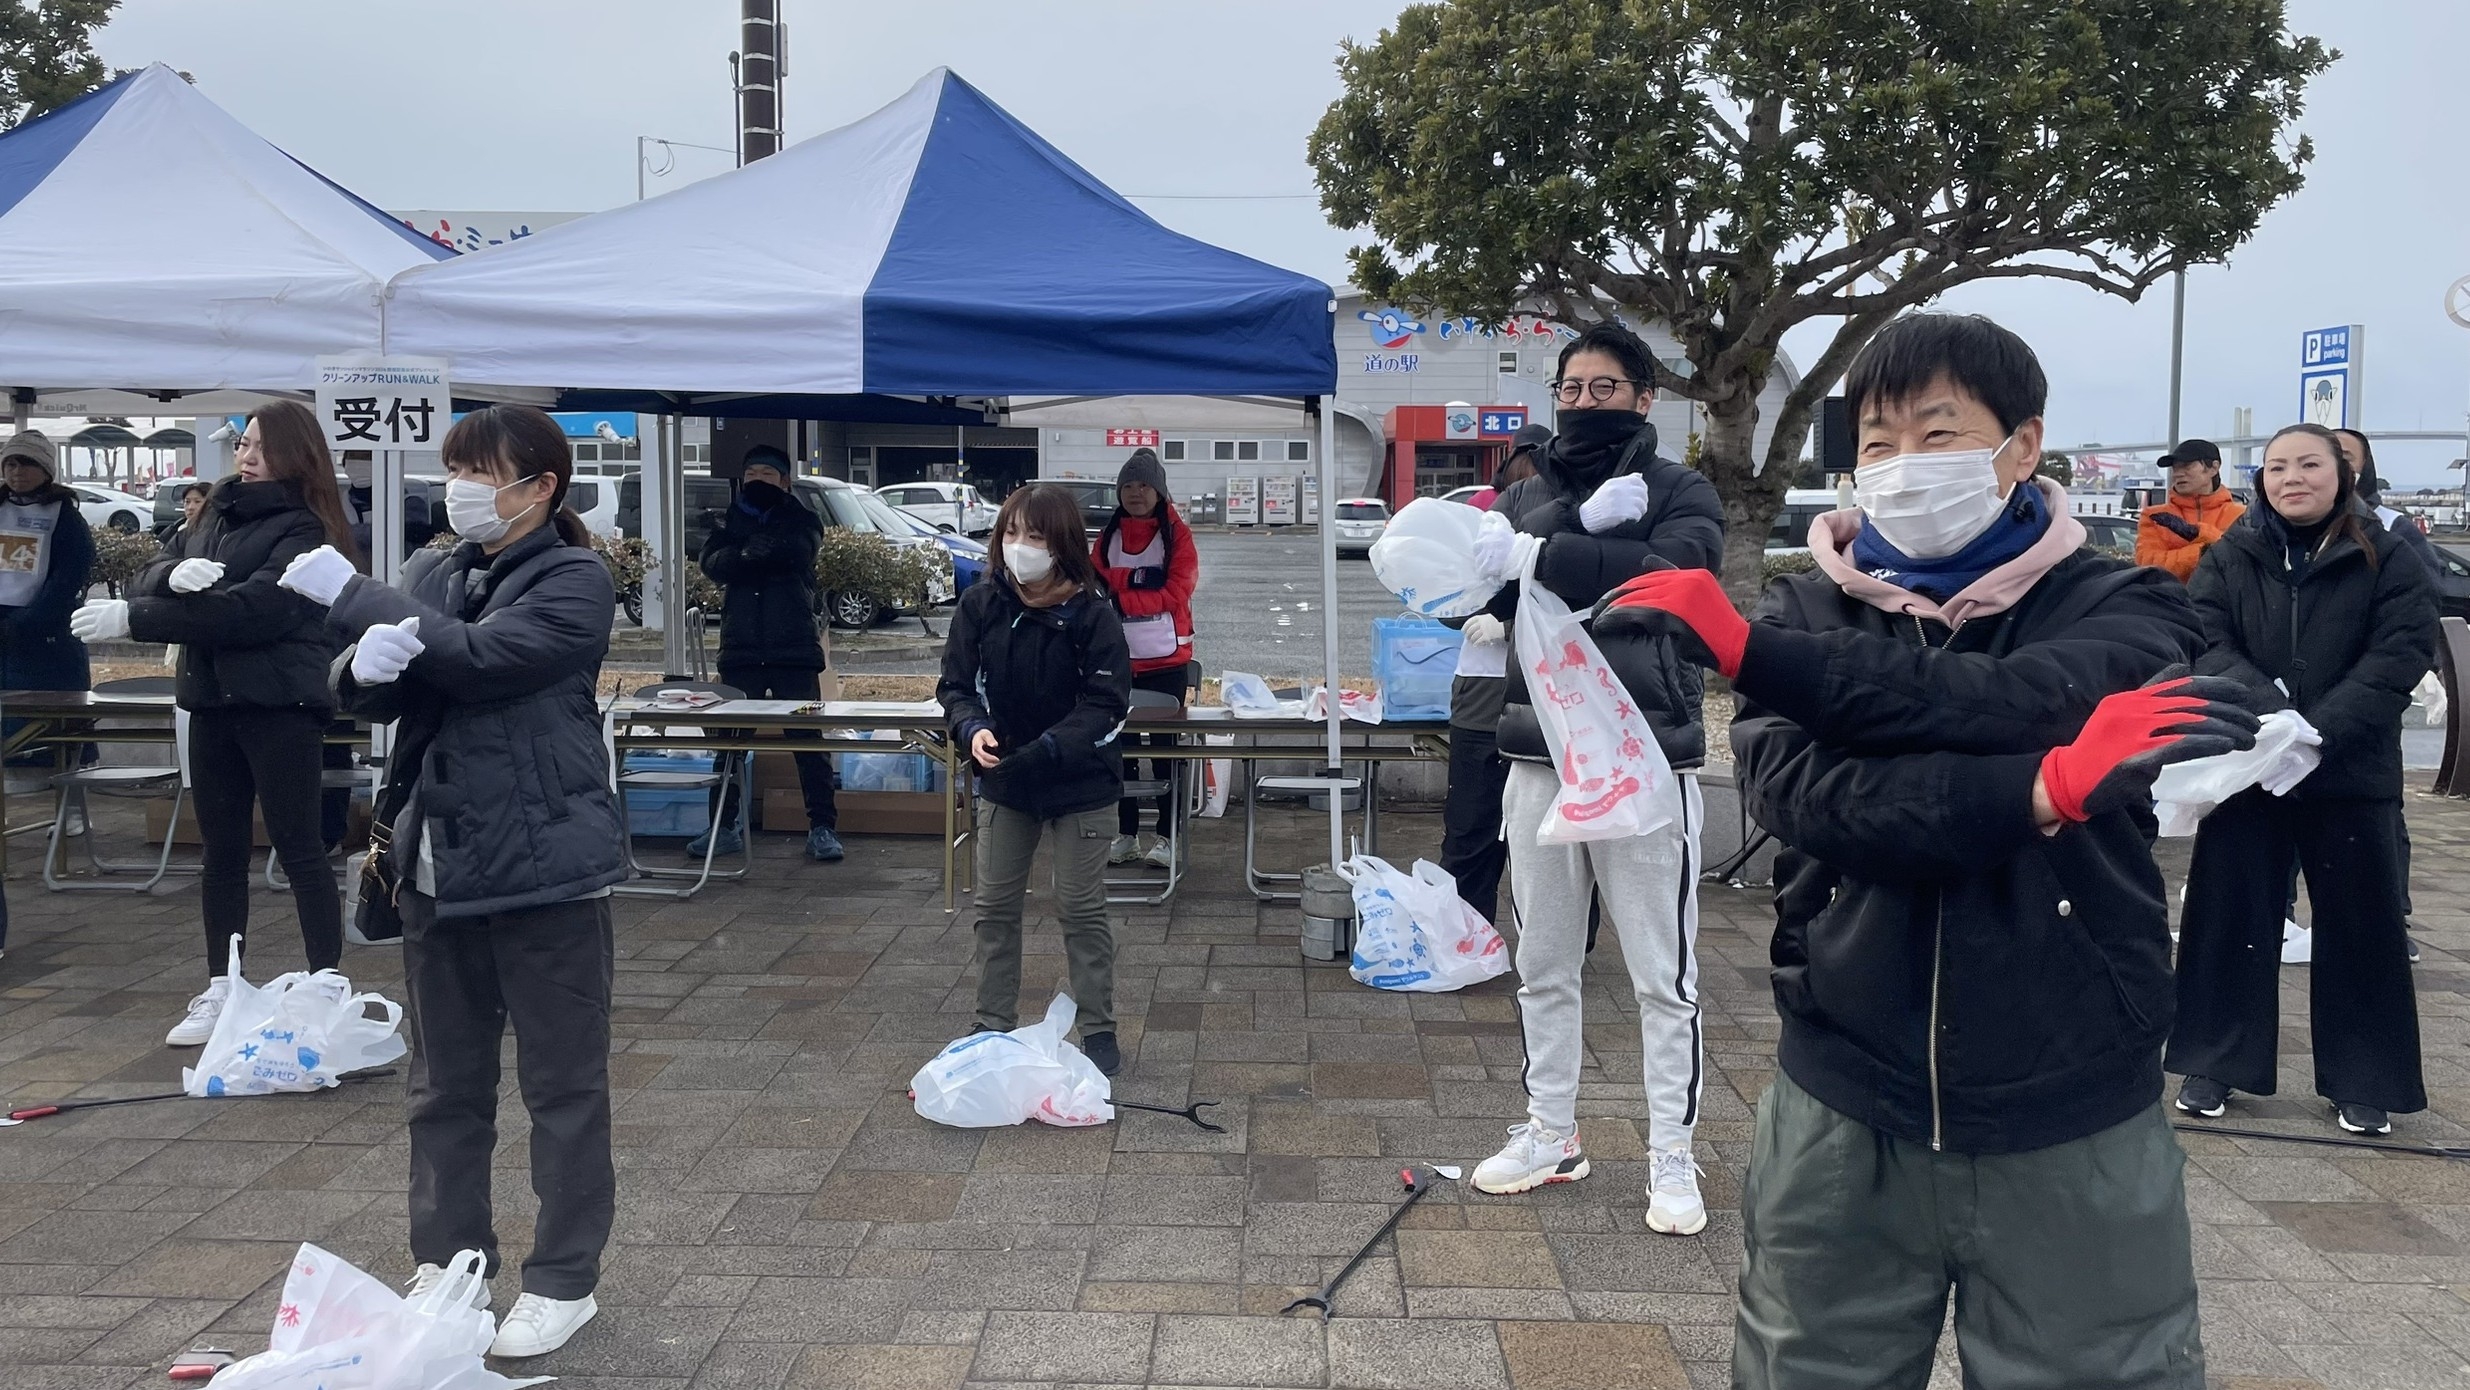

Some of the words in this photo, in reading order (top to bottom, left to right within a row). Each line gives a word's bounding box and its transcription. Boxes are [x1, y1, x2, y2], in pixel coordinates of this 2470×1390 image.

[2309, 338, 2318, 359] P
[2323, 347, 2346, 362] parking
[1364, 353, 1420, 374] 道の駅
[322, 373, 441, 385] クリーンアップRUN&WALK
[333, 396, 435, 443] 受付
[1485, 415, 1522, 431] 北口
